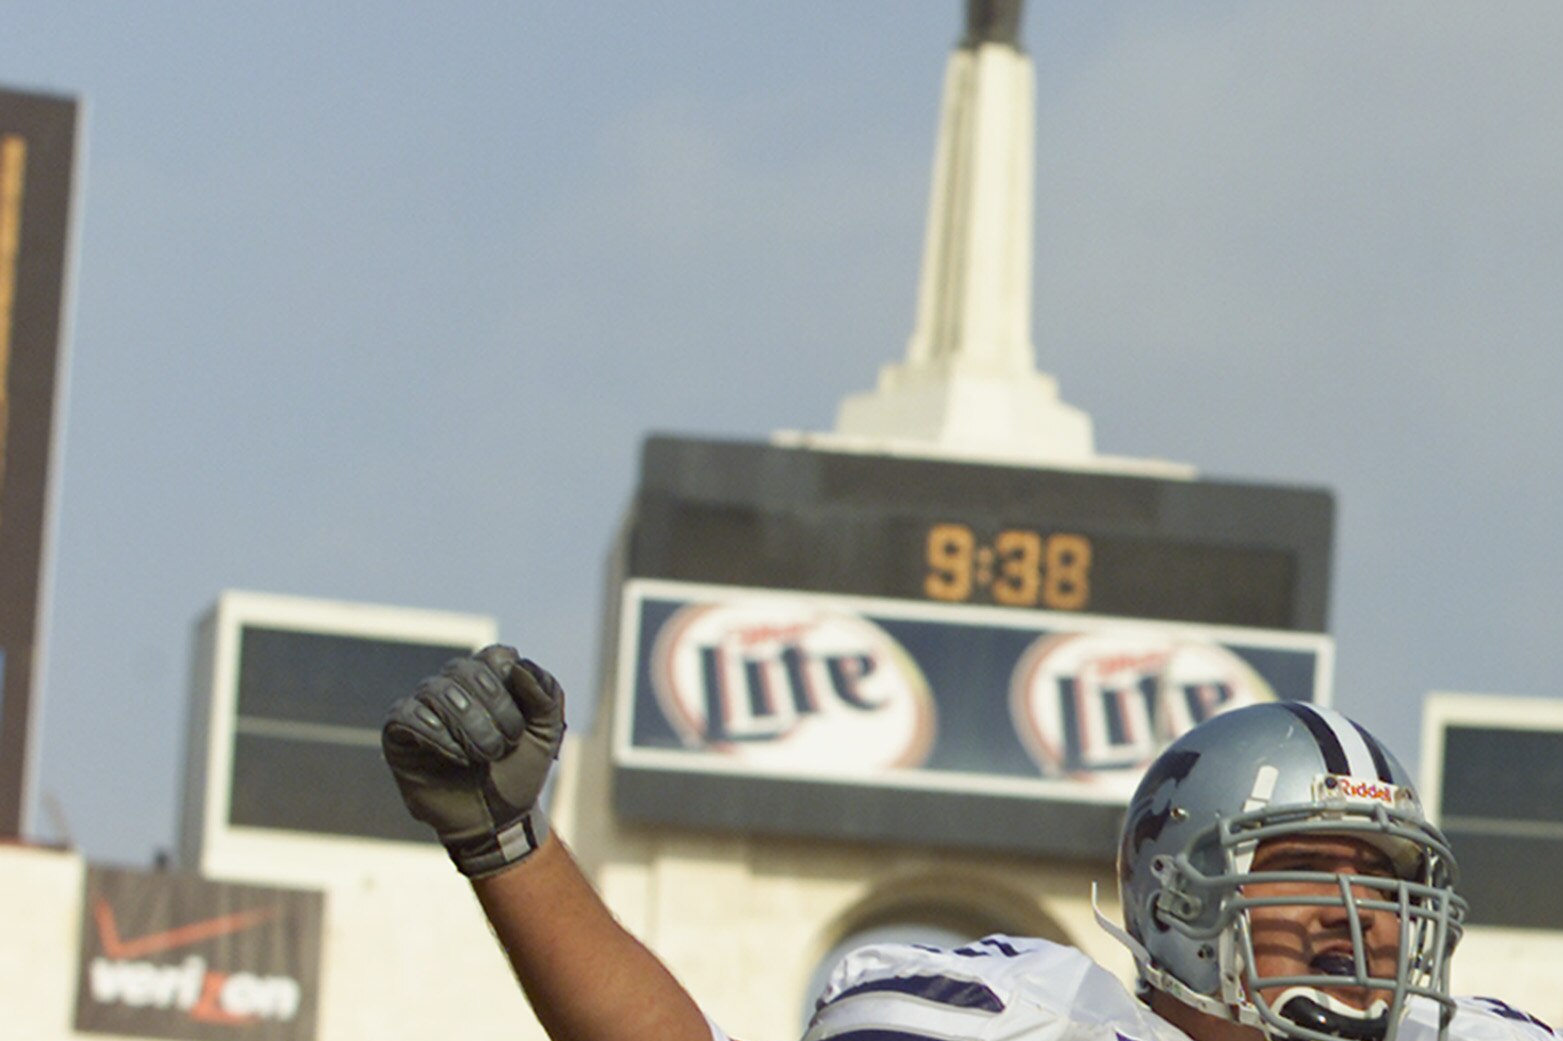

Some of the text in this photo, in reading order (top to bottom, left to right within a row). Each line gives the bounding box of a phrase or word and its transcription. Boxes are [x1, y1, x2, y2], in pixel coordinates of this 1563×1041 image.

[924, 522, 1092, 610] 9:38
[698, 641, 892, 747] Lite
[1339, 778, 1393, 802] Riddell
[90, 953, 300, 1024] verizon
